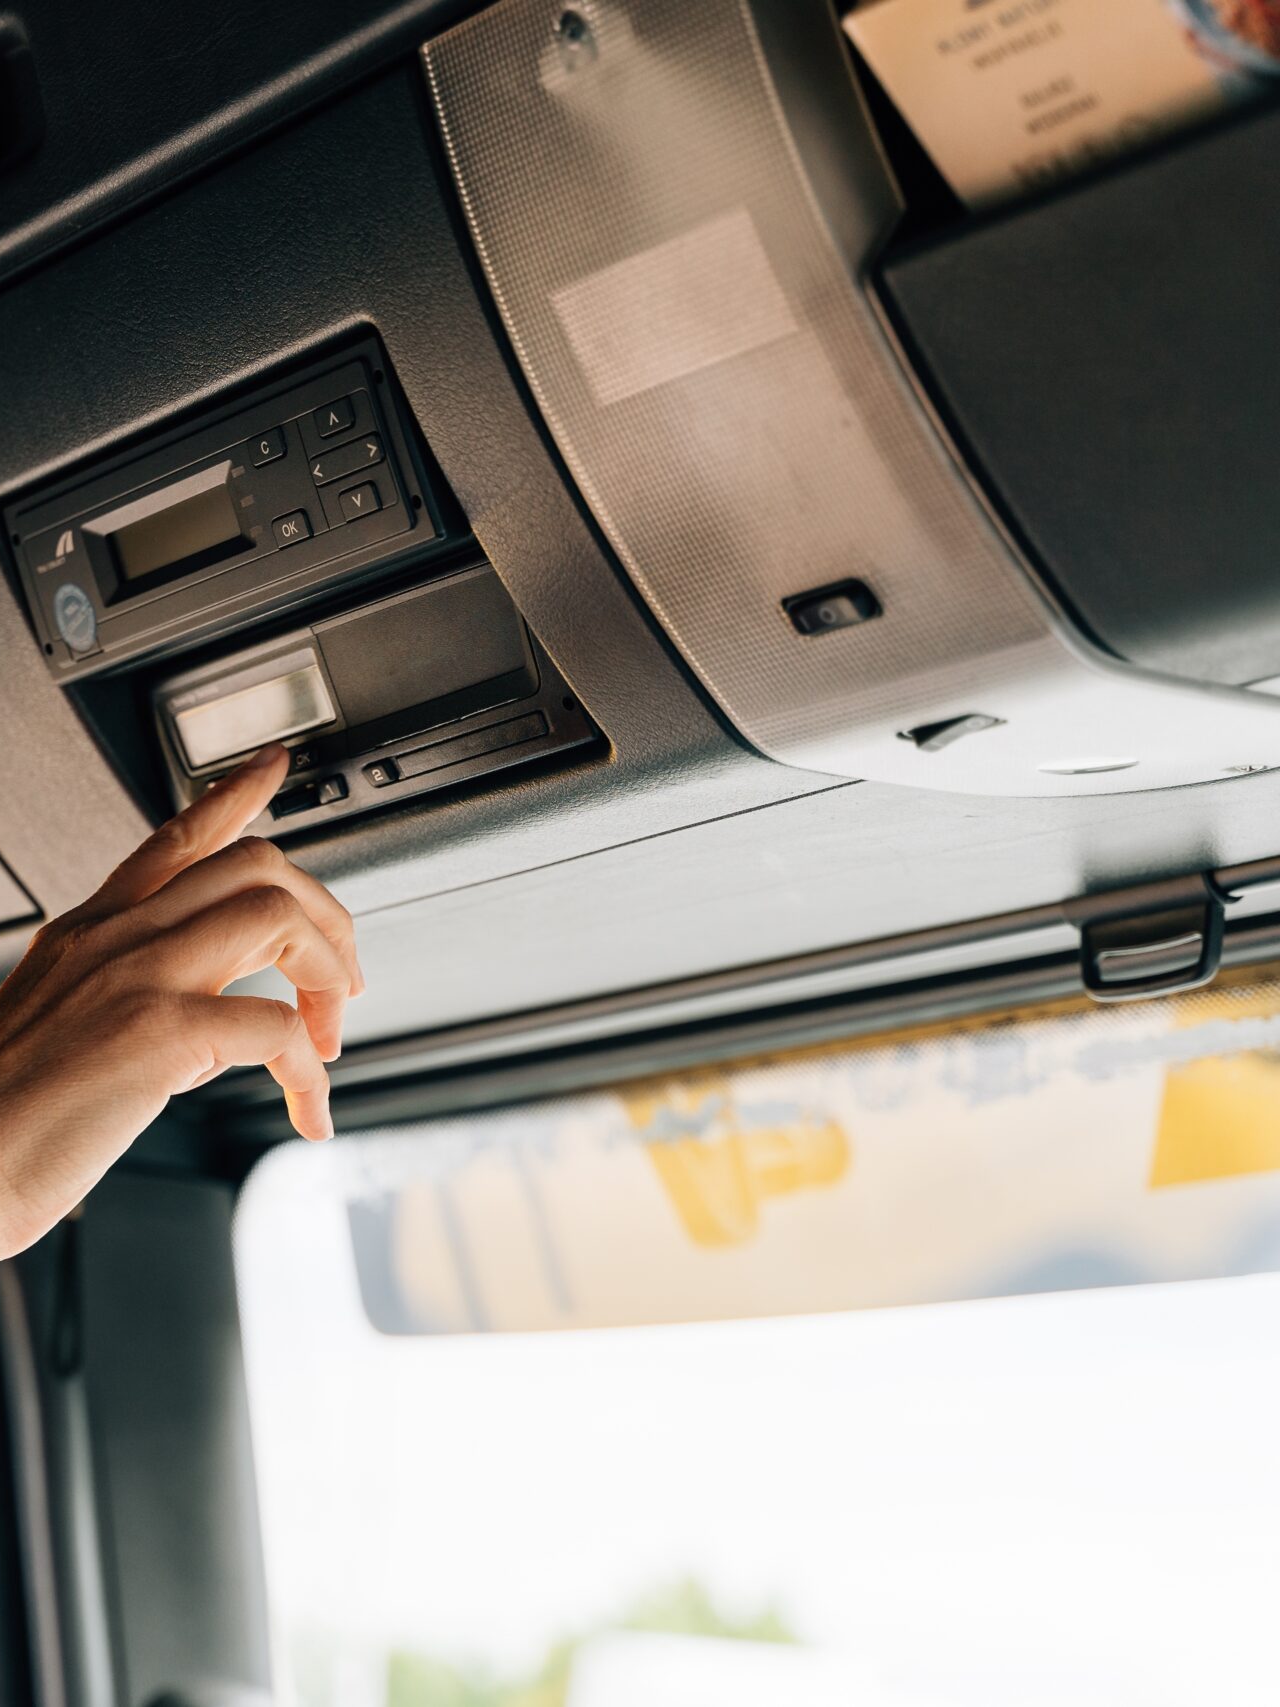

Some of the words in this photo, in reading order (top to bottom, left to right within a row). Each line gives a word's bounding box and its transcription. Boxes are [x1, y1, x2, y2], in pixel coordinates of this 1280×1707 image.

[261, 441, 269, 454] C
[282, 521, 298, 537] OK
[296, 753, 310, 765] OK
[372, 769, 383, 781] 2
